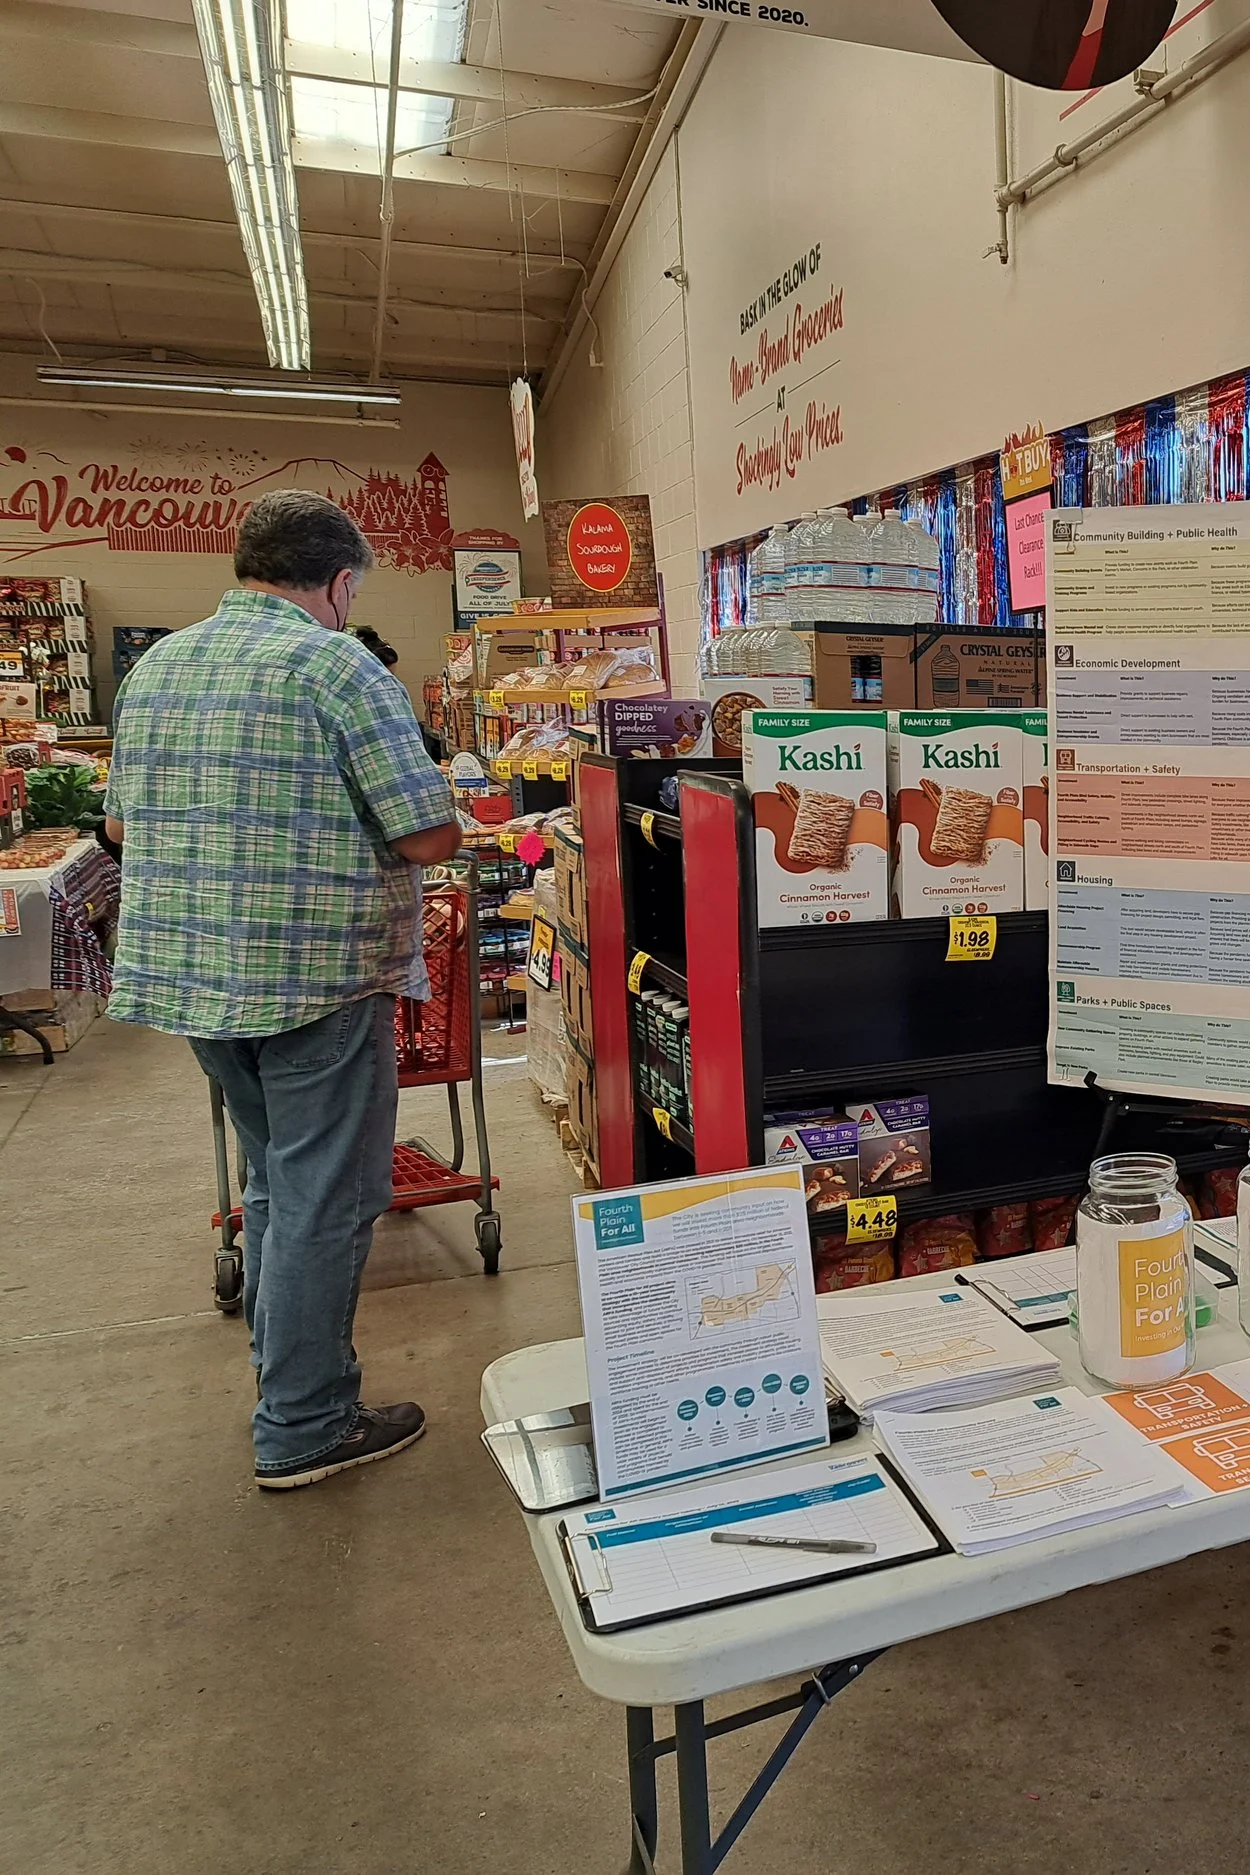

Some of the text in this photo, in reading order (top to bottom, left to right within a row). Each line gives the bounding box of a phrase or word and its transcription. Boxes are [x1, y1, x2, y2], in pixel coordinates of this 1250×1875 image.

[758, 5, 809, 26] 2020.
[740, 242, 821, 335] BASK IN THE GLOW OF
[792, 283, 844, 364] Groceries
[777, 385, 786, 412] AT
[737, 415, 803, 495] Shockingly Low
[78, 463, 236, 496] Welcome to
[8, 475, 252, 533] Vancouv
[581, 523, 613, 535] KALAMA
[1015, 516, 1025, 531] Last
[1073, 526, 1238, 542] Community Building Public Health
[576, 543, 623, 555] SOURDOUGH
[588, 564, 616, 574] BAKERY
[960, 644, 1003, 657] CRYSTAL
[1075, 659, 1180, 669] Economic Development
[615, 703, 668, 714] Chocolatey
[615, 713, 654, 721] DIPPED
[758, 719, 810, 727] FAMILY SIZE
[903, 719, 952, 727] FAMILY SIZE
[615, 722, 657, 736] goodness
[778, 743, 863, 771] Kashi
[922, 742, 1000, 769] Kashi
[1076, 763, 1181, 775] Transportation Safety
[809, 882, 842, 892] Organic
[950, 876, 980, 886] Organic
[1077, 875, 1113, 886] Housing
[922, 883, 1006, 895] Cinnamon Harvest
[779, 890, 871, 903] Cinnamon Harvest
[1076, 995, 1171, 1011] Parks Public Spaces
[599, 1203, 633, 1216] Fourth
[600, 1215, 626, 1227] Plain
[850, 1209, 897, 1230] $4.48
[601, 1223, 635, 1237] For All
[1136, 1277, 1182, 1302] Plain
[1136, 1306, 1172, 1326] For
[1136, 1331, 1166, 1341] Investing
[1140, 1404, 1240, 1433] TRANSPORTATION
[1181, 1416, 1224, 1430] SAFETY
